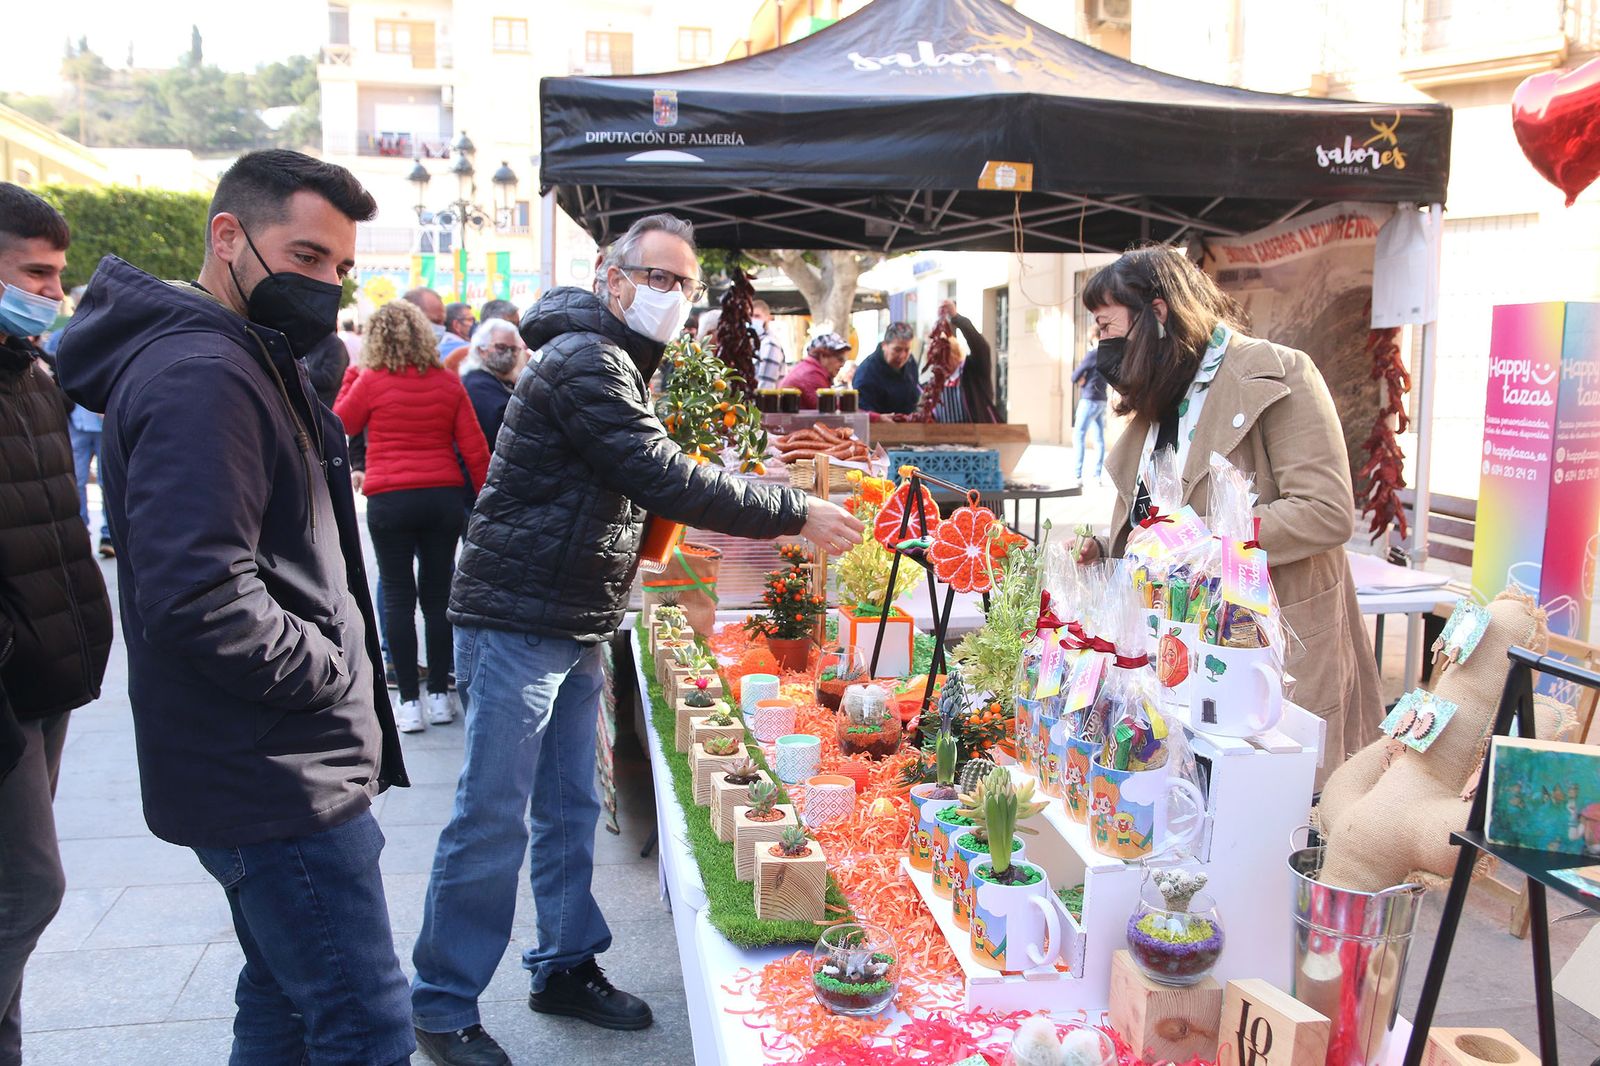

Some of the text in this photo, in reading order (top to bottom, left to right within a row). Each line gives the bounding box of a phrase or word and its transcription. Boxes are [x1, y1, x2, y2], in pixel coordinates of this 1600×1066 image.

[585, 129, 745, 146] DIPUTACIÓN DE ALMERÍA
[1315, 134, 1408, 170] sabores
[1329, 166, 1370, 176] ALMERÍA
[1489, 356, 1531, 384] Happy
[1502, 384, 1554, 406] tazas
[1504, 465, 1515, 478] 20
[1515, 466, 1526, 479] 24
